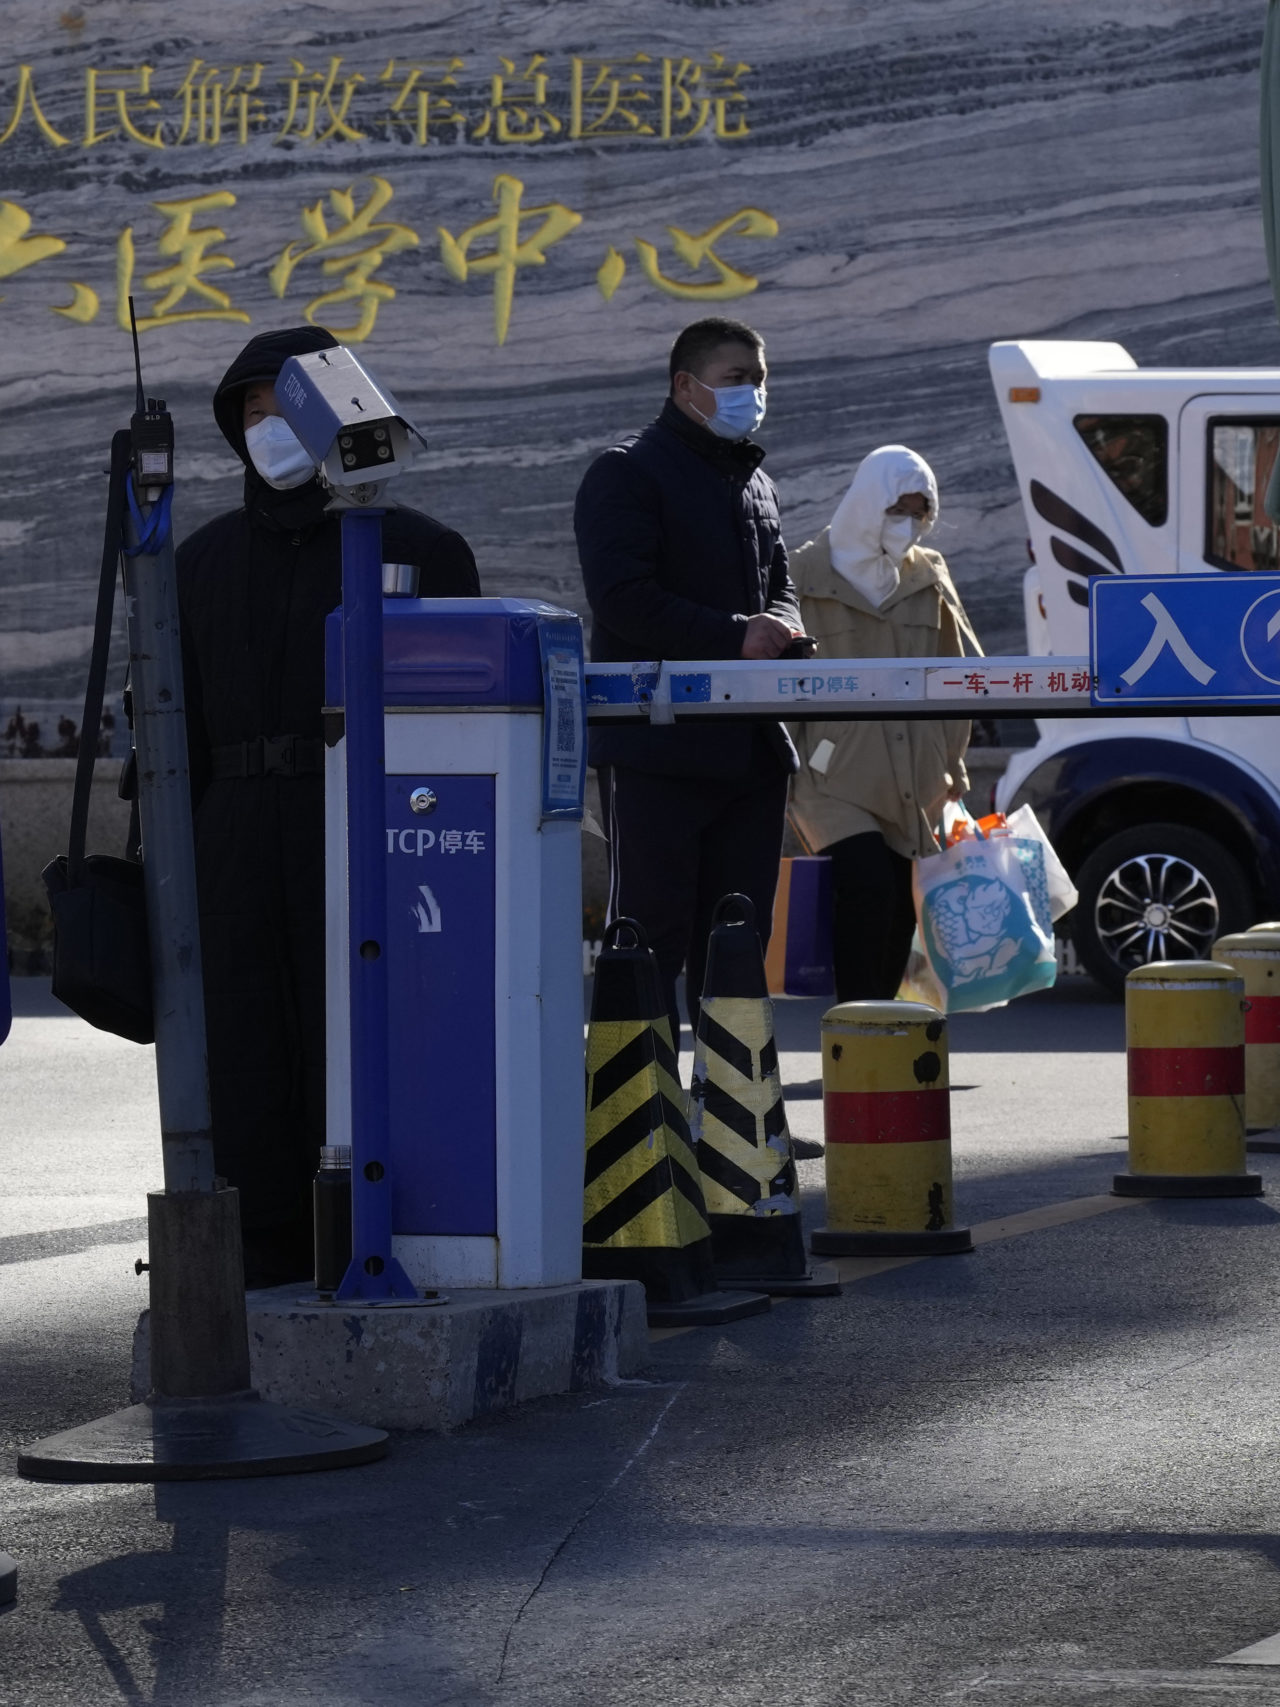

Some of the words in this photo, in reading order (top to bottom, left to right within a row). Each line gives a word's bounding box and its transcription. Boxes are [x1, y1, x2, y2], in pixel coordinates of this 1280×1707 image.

[0, 54, 752, 148] 人民解放军总医院
[943, 673, 1034, 693] 一车一杆
[1119, 591, 1217, 686] 入
